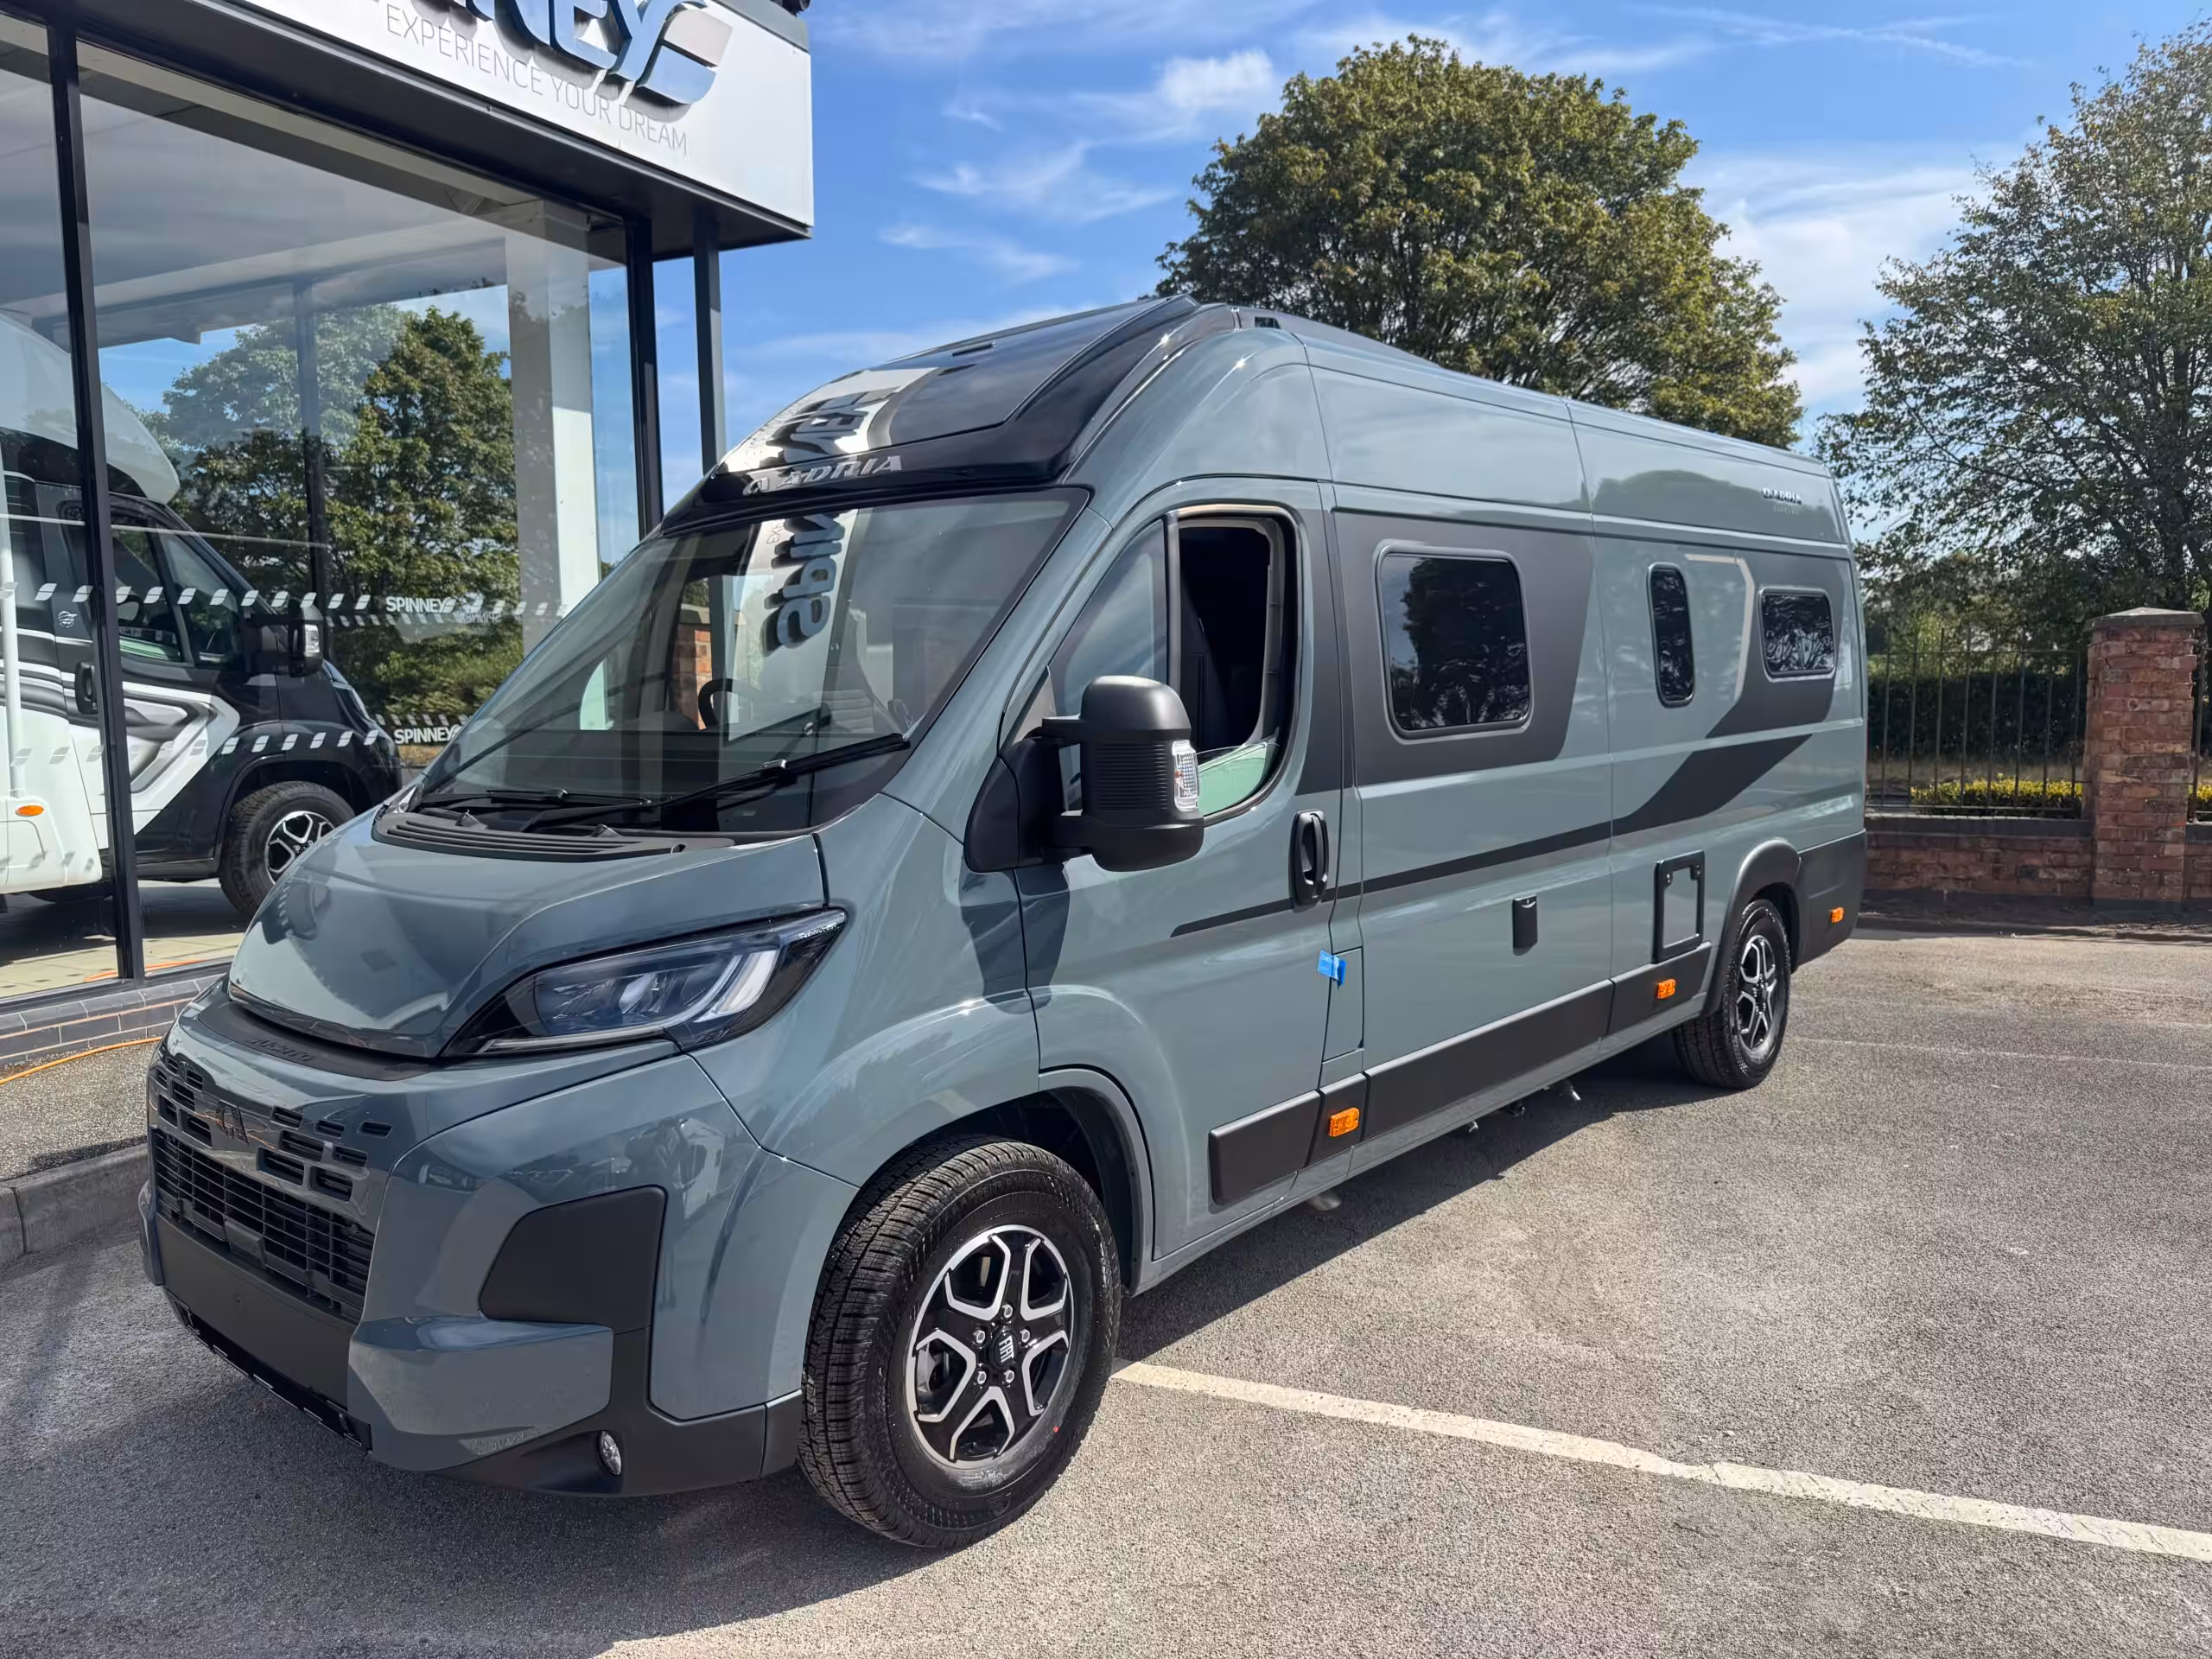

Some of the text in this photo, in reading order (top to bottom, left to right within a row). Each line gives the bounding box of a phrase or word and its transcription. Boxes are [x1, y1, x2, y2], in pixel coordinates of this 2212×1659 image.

[385, 3, 688, 156] EXPERIENCE YOUR DREAM
[777, 455, 903, 489] ADRIA
[385, 596, 451, 613] SPINNEY
[393, 726, 456, 745] SPINNEY
[998, 1335, 1014, 1363] FIAT
